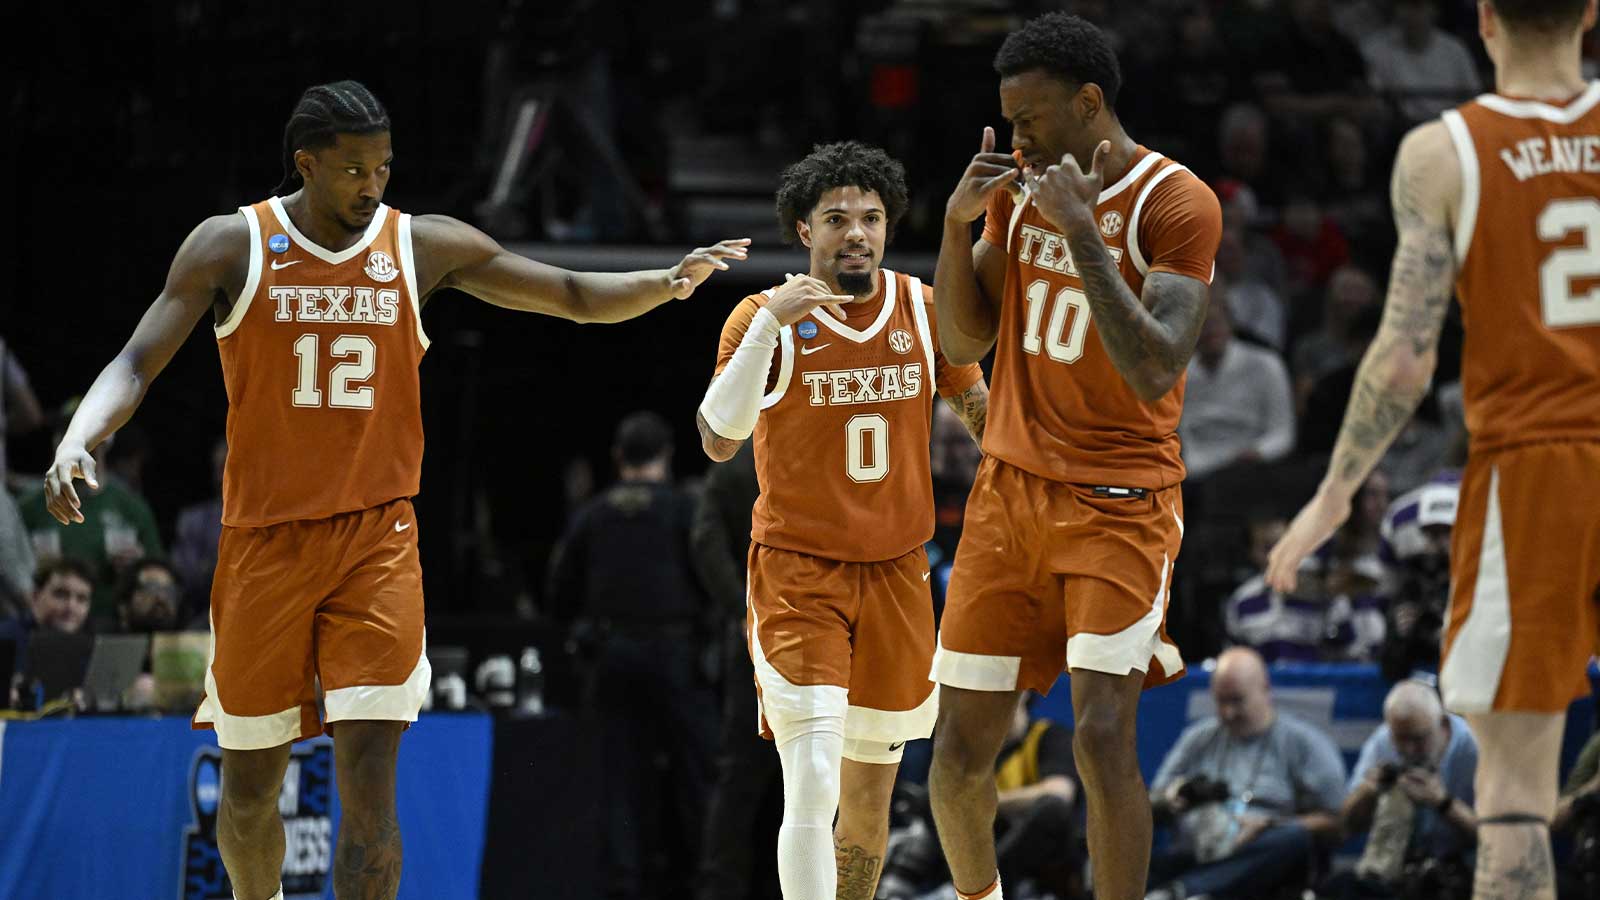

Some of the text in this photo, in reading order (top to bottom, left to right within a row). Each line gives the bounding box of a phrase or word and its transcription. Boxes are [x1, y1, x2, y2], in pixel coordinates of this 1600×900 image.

[1102, 213, 1121, 235] SEC
[371, 253, 392, 274] SEC
[1019, 224, 1123, 277] TEX
[1537, 197, 1600, 328] 2
[269, 285, 399, 326] TEXAS
[1024, 279, 1091, 364] 10
[891, 330, 911, 352] SEC
[292, 333, 376, 410] 12
[802, 363, 921, 406] TEXAS
[845, 412, 889, 483] 0
